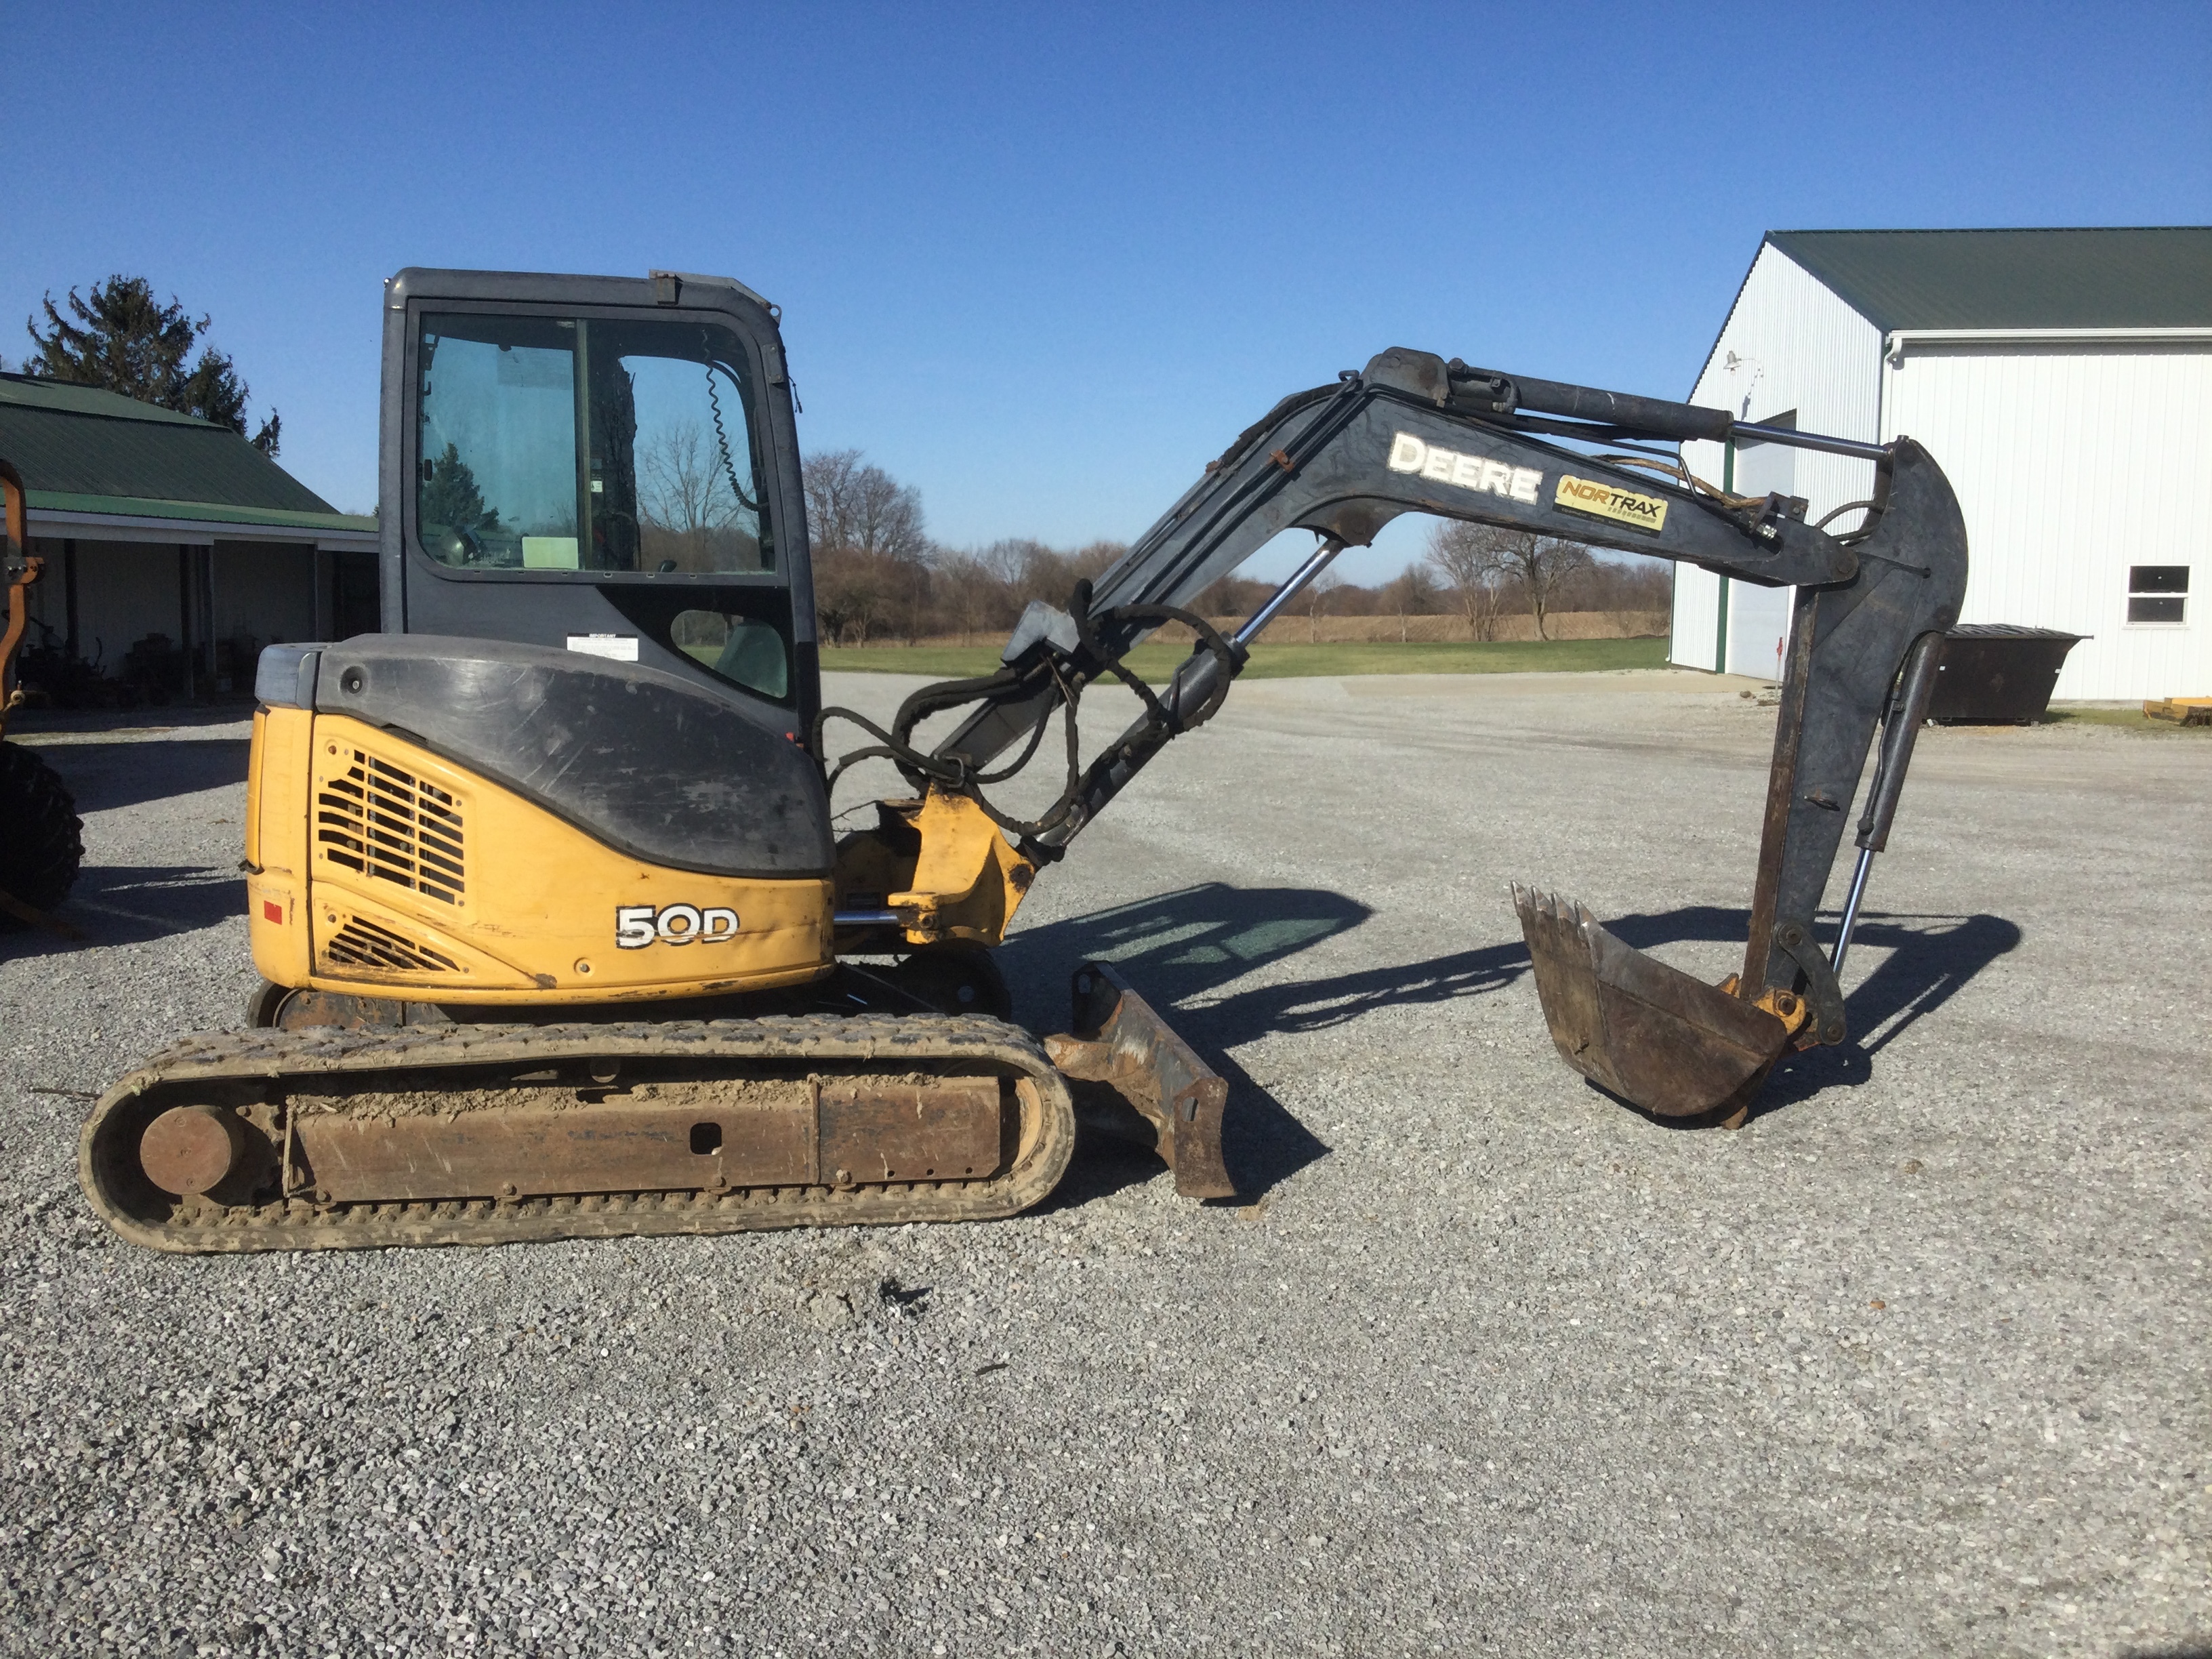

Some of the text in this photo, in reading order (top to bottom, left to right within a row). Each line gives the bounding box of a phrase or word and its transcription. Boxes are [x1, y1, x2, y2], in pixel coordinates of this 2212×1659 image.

[1388, 430, 1542, 504] DEERE
[1562, 480, 1662, 518] NORTRAX
[615, 903, 740, 949] 50D
